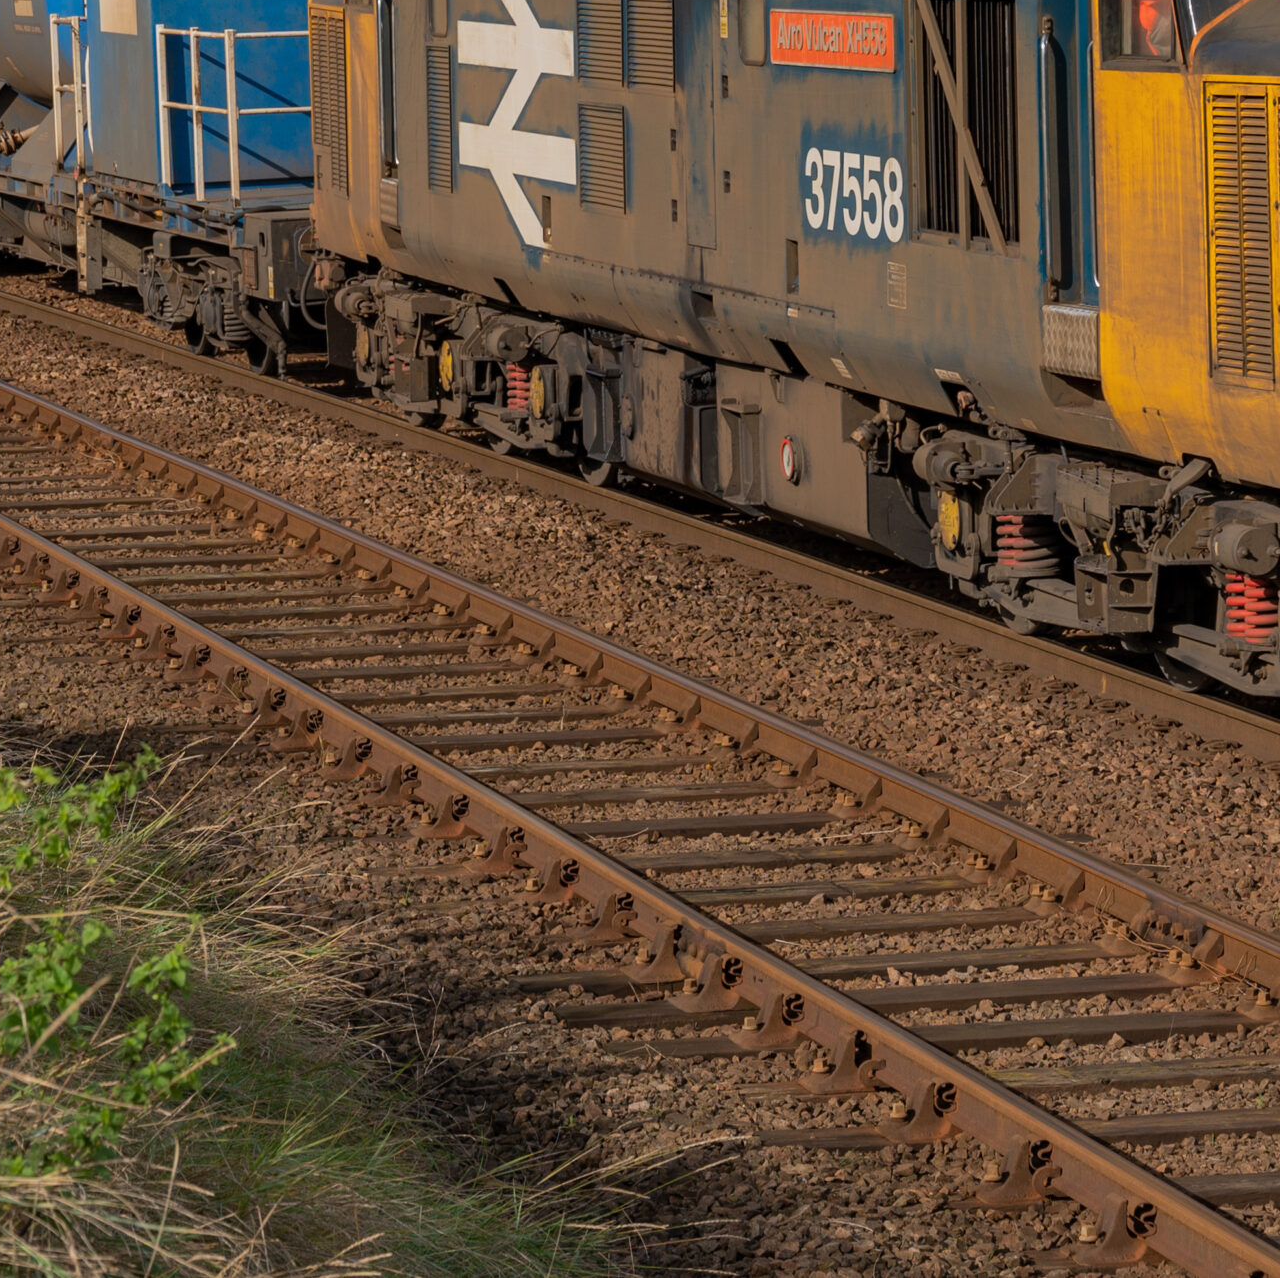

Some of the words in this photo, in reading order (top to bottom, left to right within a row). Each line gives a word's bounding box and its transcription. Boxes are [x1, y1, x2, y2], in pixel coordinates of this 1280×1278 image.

[777, 17, 803, 51] Avro
[804, 18, 843, 53] Vulcan
[846, 21, 886, 56] XH558
[805, 147, 904, 243] 37558
